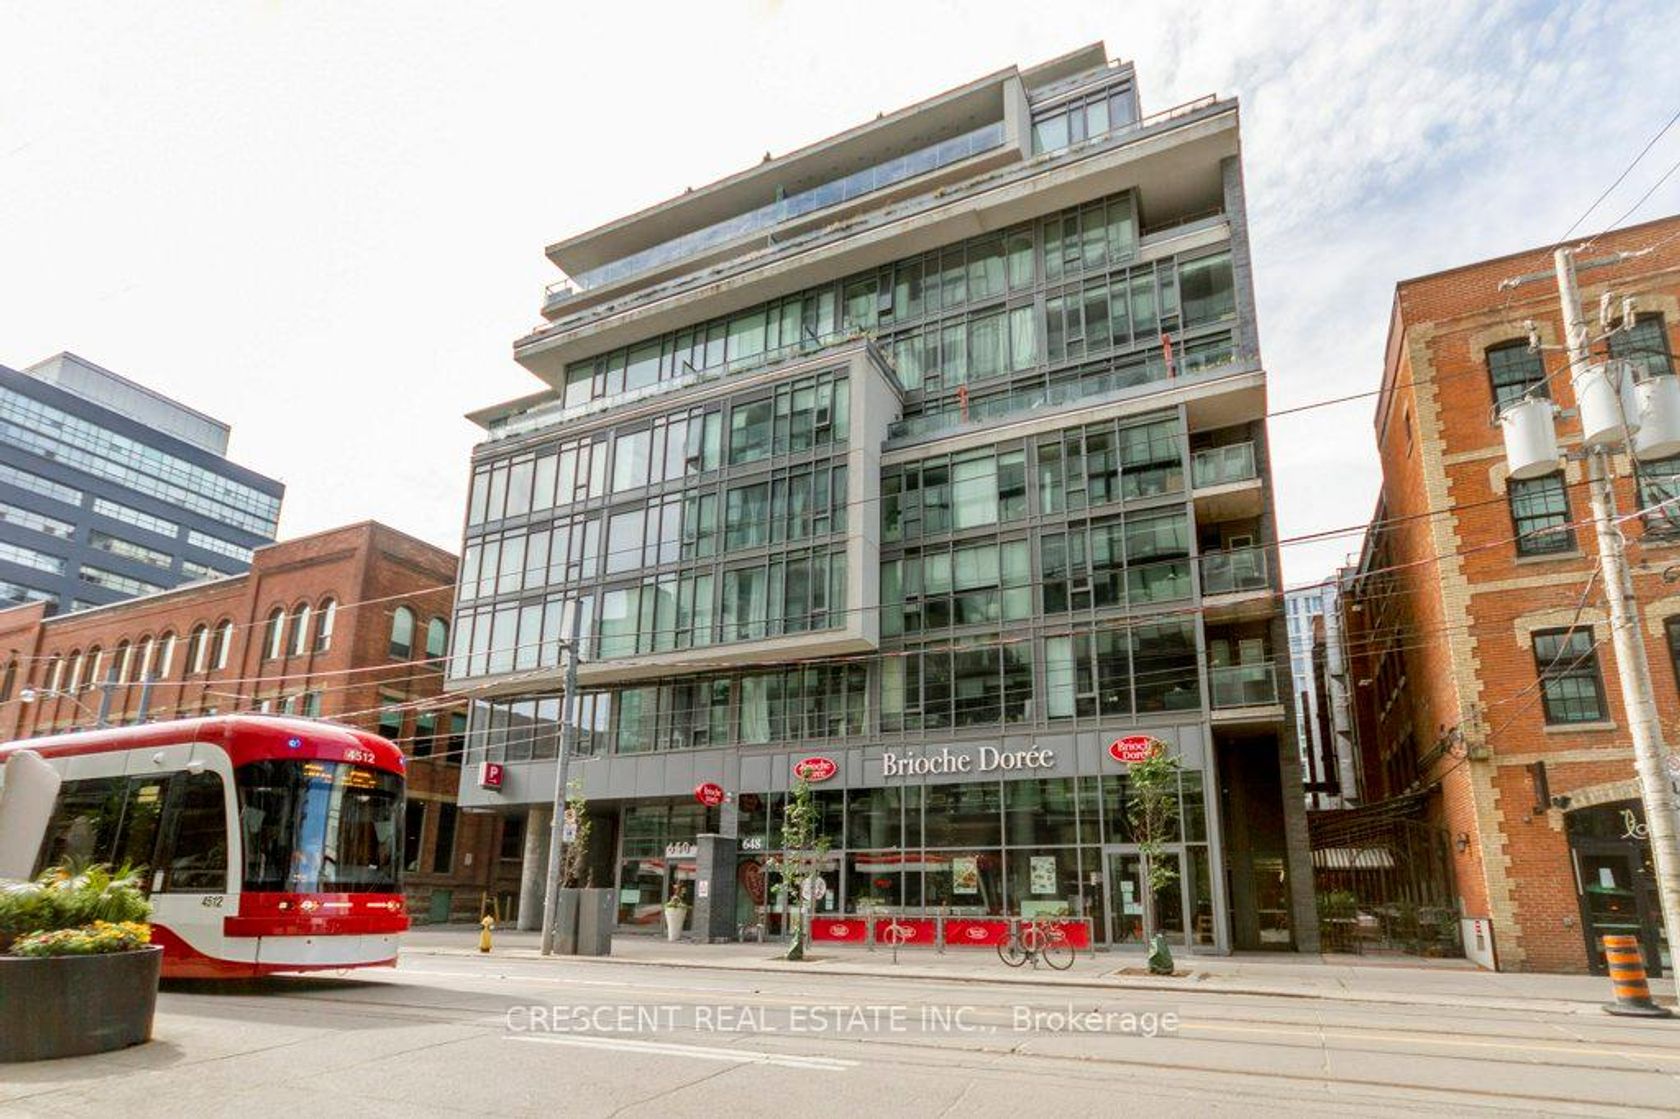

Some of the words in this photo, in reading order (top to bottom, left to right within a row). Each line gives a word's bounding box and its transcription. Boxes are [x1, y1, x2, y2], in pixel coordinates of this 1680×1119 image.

[883, 748, 971, 776] Brioche
[979, 745, 1054, 771] Dorée
[490, 766, 499, 778] P
[743, 839, 760, 849] 648
[202, 896, 223, 907] 4512
